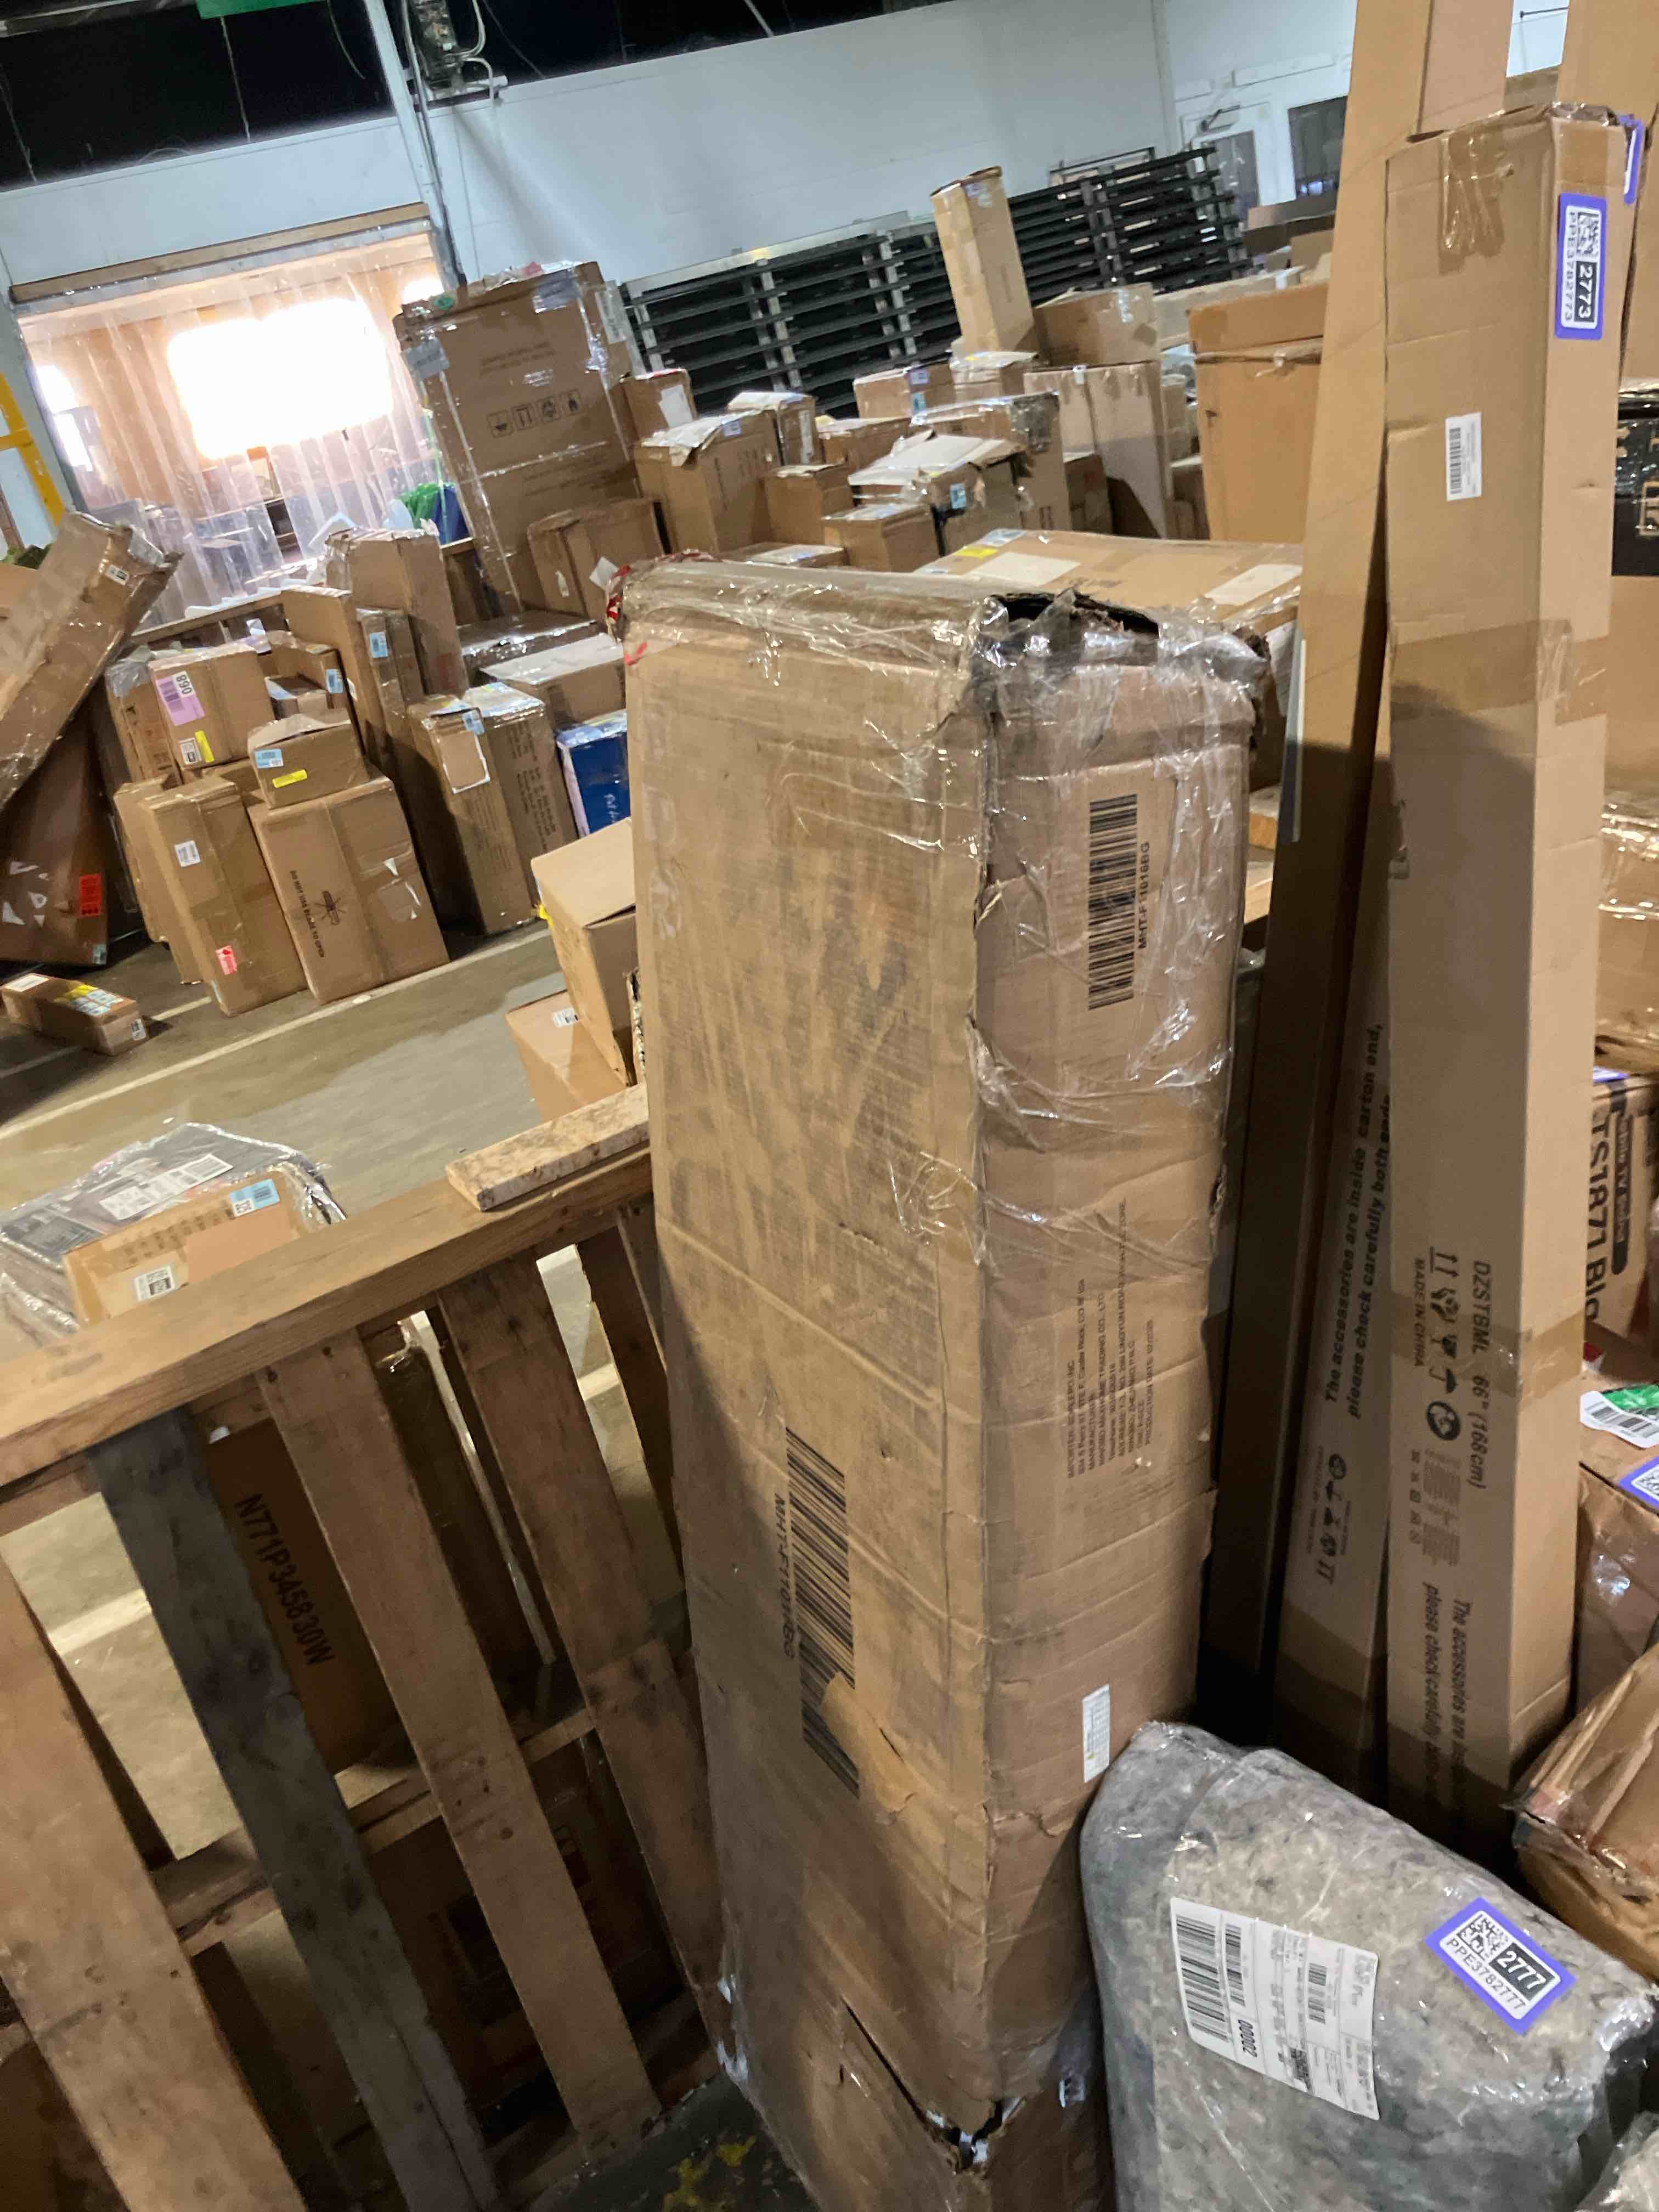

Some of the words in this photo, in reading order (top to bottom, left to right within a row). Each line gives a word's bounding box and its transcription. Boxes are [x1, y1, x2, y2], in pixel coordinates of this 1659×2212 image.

[1565, 212, 1576, 321] PPE3782773
[1578, 264, 1593, 319] 2773
[1357, 1072, 1374, 1138] carton
[1346, 1148, 1365, 1207] inside
[1372, 1148, 1389, 1193] both
[1346, 1212, 1358, 1244] are
[1363, 1197, 1386, 1286] carefully
[1333, 1249, 1354, 1365] accessories
[1413, 1258, 1425, 1300] MADE
[1354, 1290, 1372, 1349] check
[1414, 1303, 1425, 1318] IN
[1414, 1322, 1425, 1367] CHINA
[1325, 1369, 1340, 1403] The
[1346, 1352, 1365, 1420] please
[1466, 1410, 1489, 1489] (168cm)
[1422, 1581, 1443, 1632] please
[1447, 1938, 1527, 2010] PPE3782777
[1497, 1950, 1547, 1990] 2777
